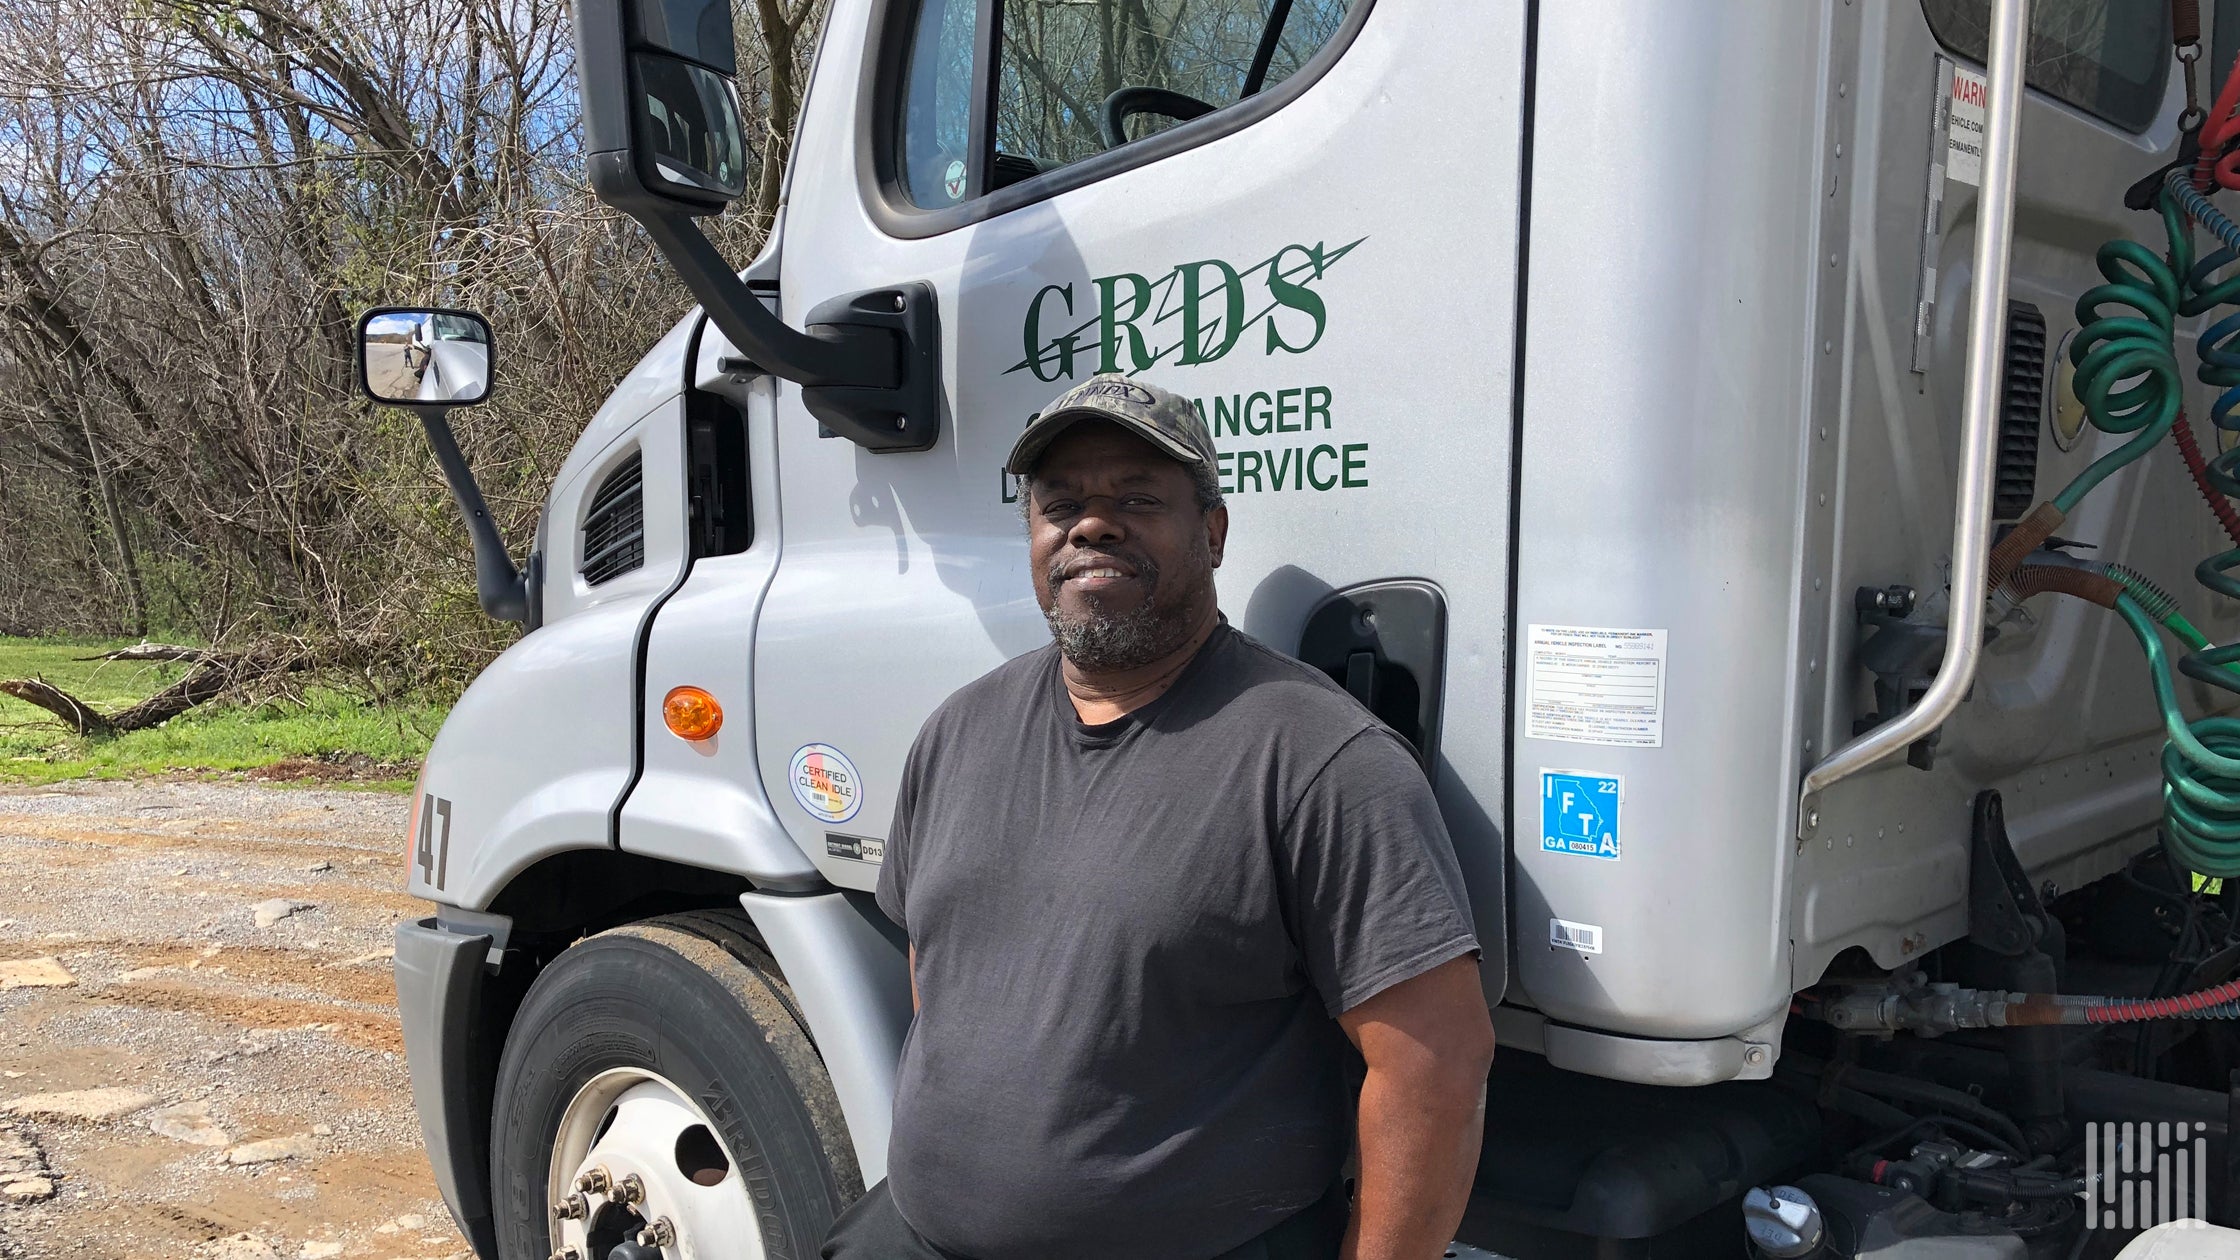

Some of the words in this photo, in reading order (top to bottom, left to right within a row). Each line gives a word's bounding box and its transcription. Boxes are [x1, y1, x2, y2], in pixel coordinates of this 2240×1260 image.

[1952, 77, 1986, 108] WARN
[1952, 115, 1970, 129] EHICLE
[1971, 122, 1983, 133] COM
[1950, 139, 1982, 156] ERMANENTL
[1023, 240, 1327, 383] GRDS
[1193, 385, 1332, 438] ANGER
[1216, 442, 1368, 494] ERVICE
[802, 765, 846, 783] CERTIFIED
[799, 776, 828, 792] CLEAN
[832, 784, 852, 797] IDLE
[1598, 781, 1617, 794] 22
[418, 793, 452, 892] 47
[862, 845, 883, 857] DD13
[1545, 836, 1566, 850] GA
[702, 1079, 789, 1260] BRIDG
